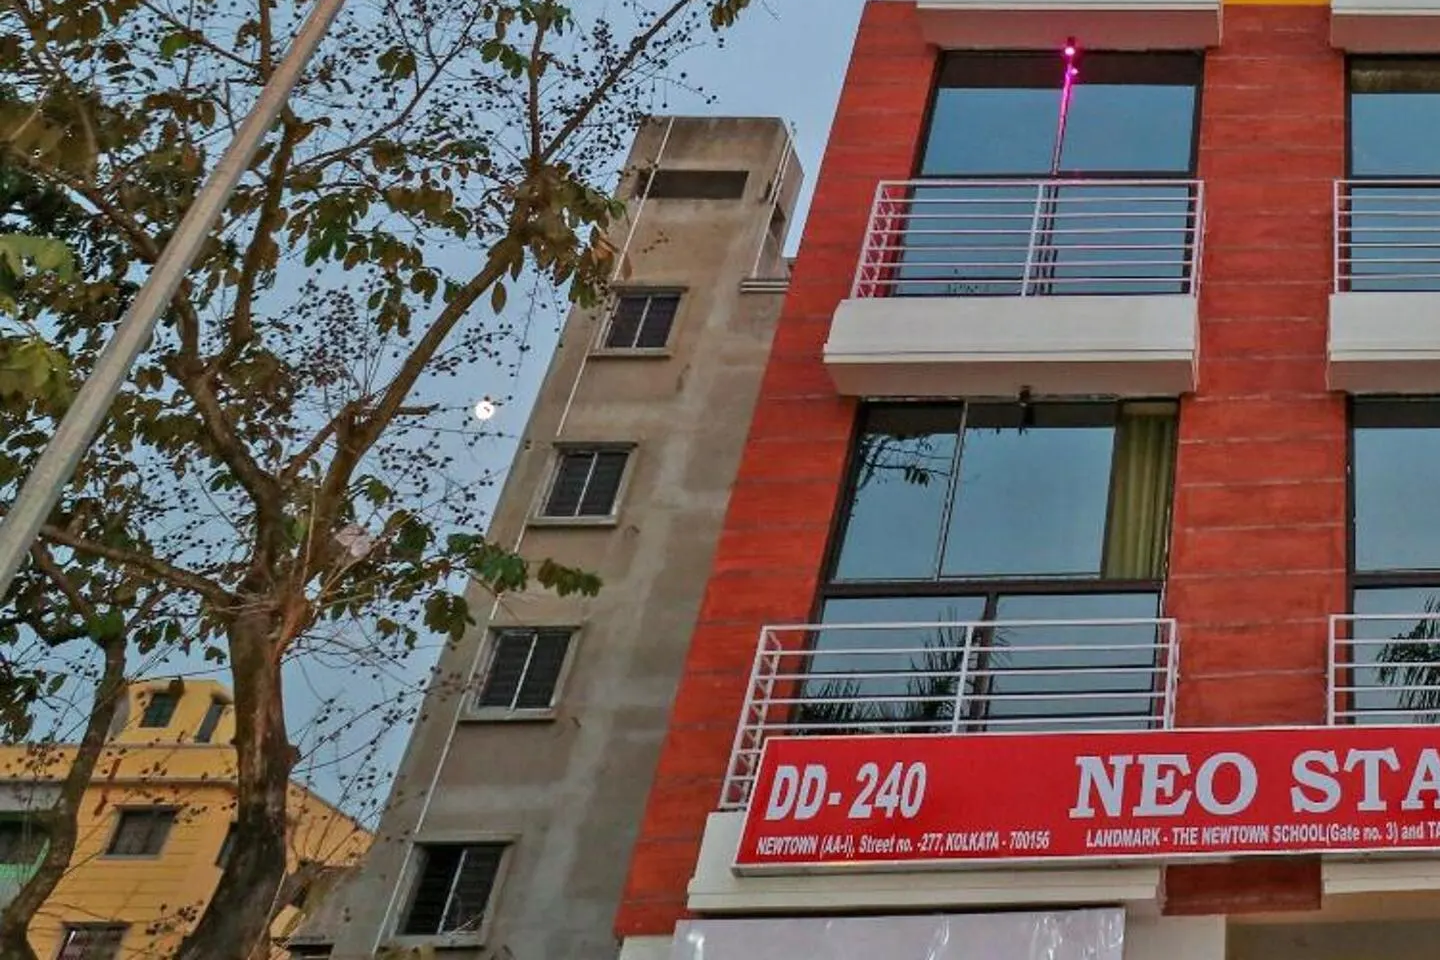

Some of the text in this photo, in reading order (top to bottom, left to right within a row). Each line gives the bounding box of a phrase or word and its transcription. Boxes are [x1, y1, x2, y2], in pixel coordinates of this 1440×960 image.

[848, 761, 927, 819] 240
[1069, 751, 1258, 818] NEO
[756, 836, 818, 855] NEWTOWN
[858, 833, 895, 853] Street
[896, 838, 912, 852] no.
[1009, 831, 1050, 849] 700156
[1086, 828, 1160, 848] LANDMARK
[1172, 827, 1198, 845] THE
[1201, 825, 1269, 845] NEWTOWN
[1363, 826, 1381, 841] no.
[1385, 821, 1398, 843] 3)
[1401, 821, 1424, 840] and
